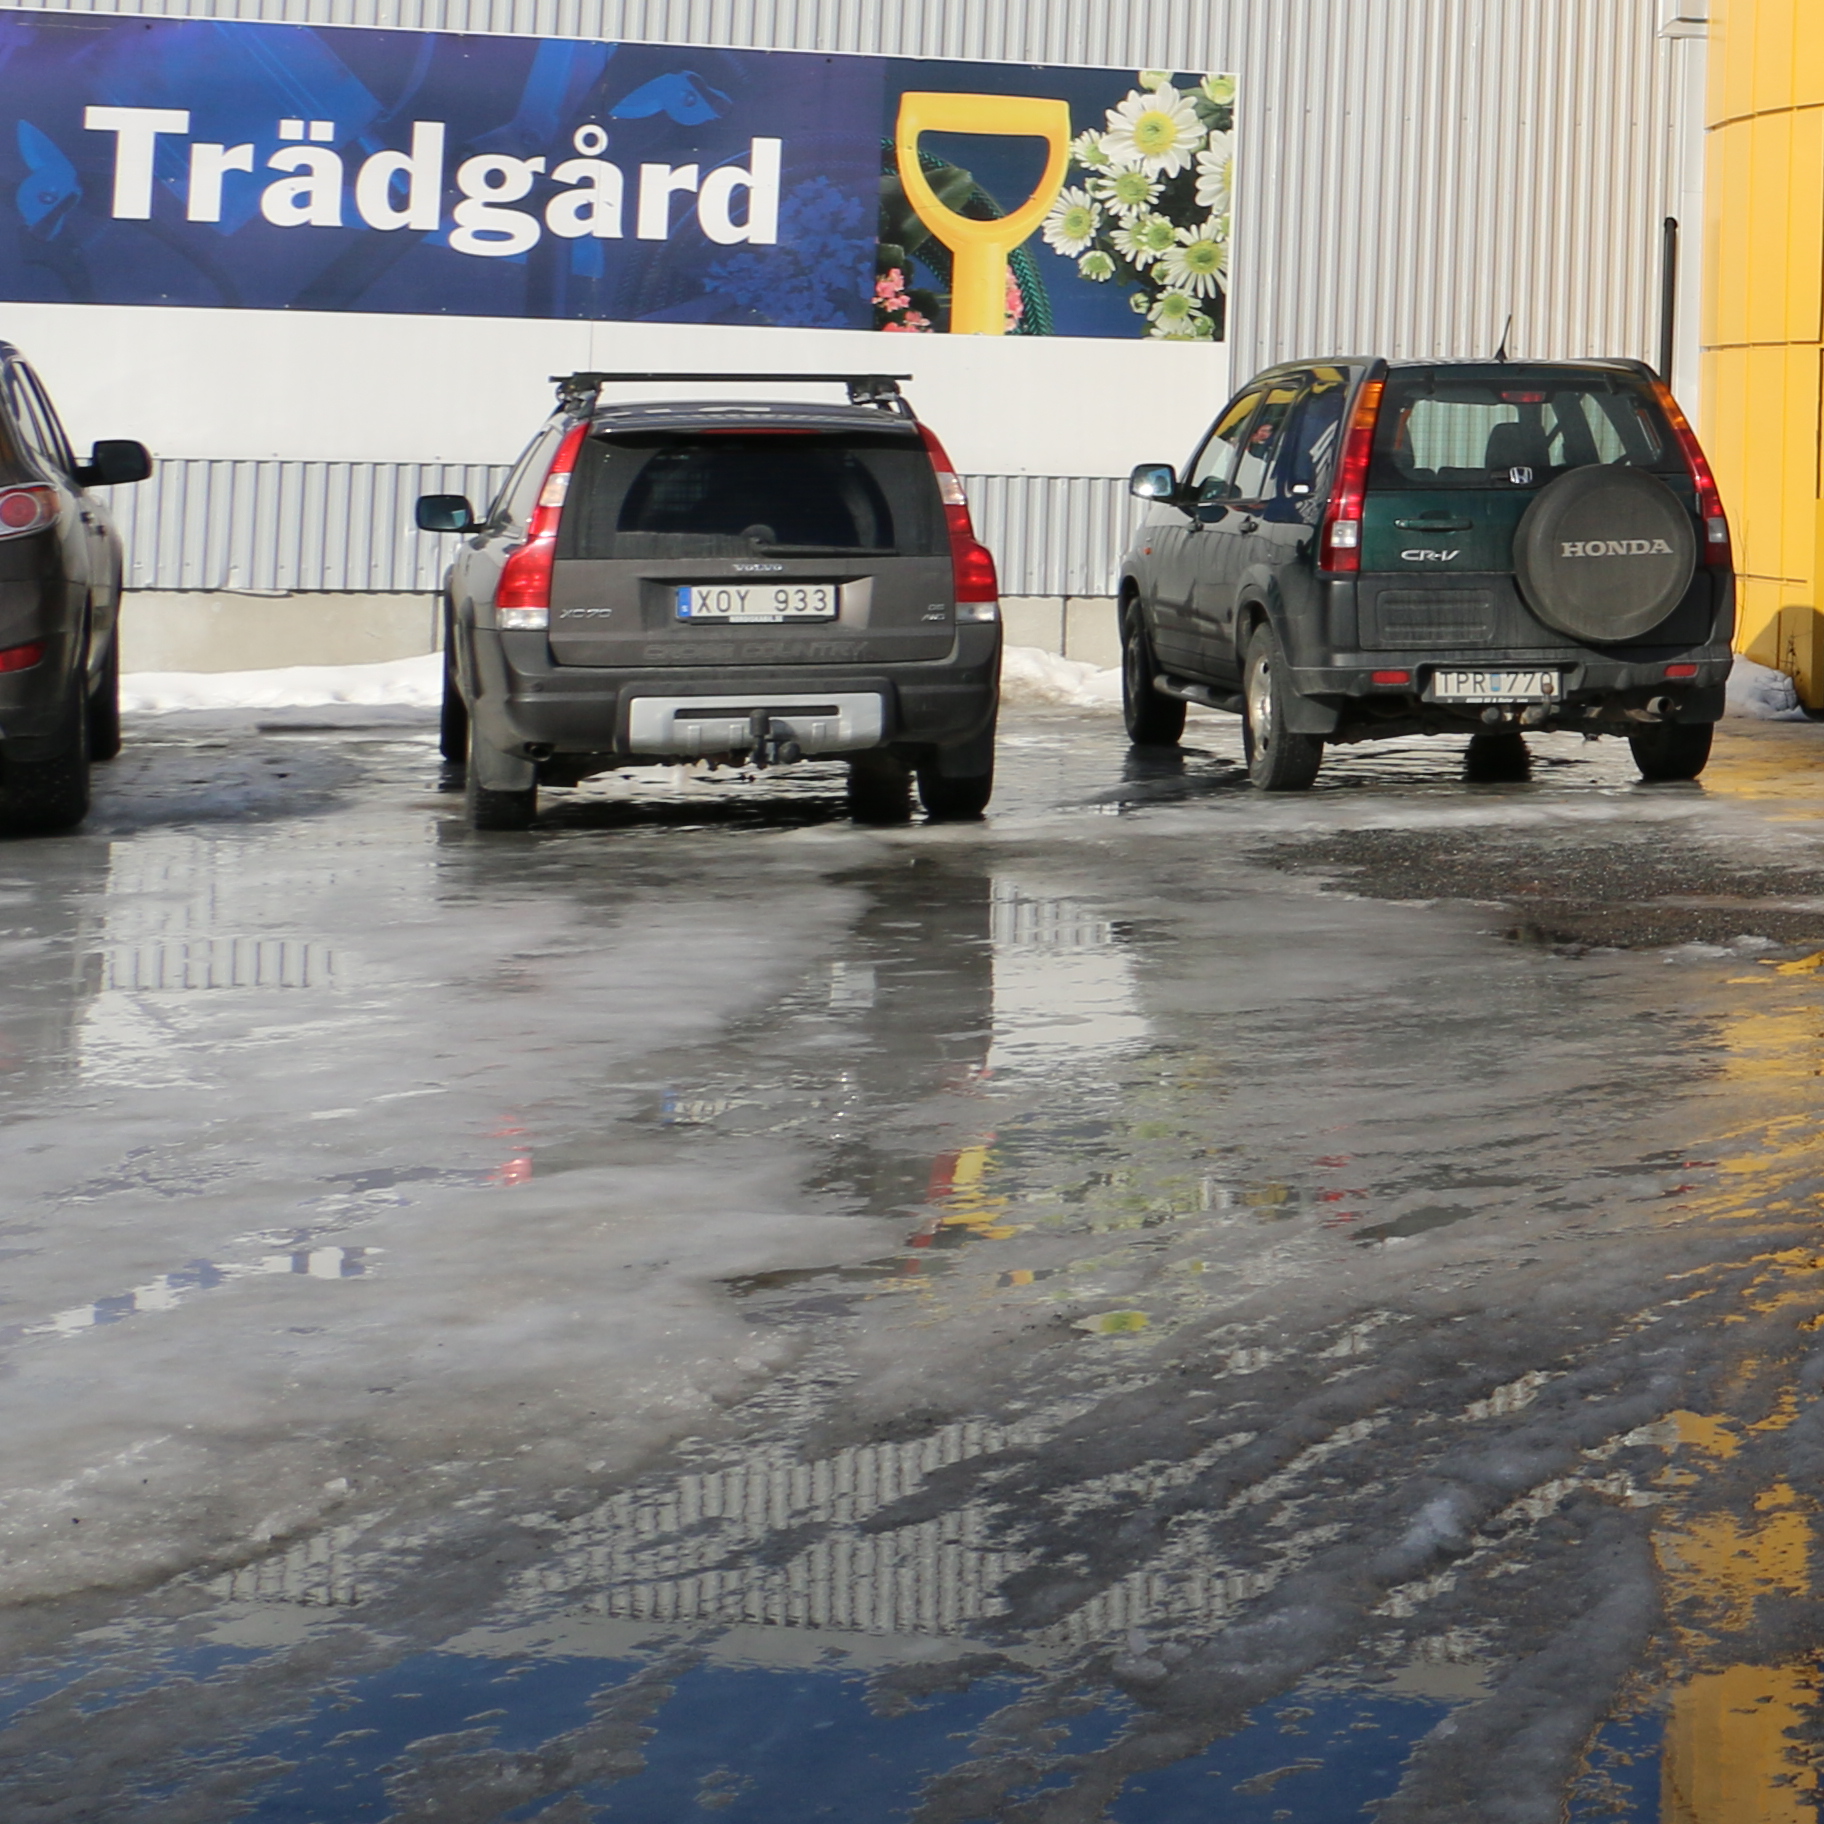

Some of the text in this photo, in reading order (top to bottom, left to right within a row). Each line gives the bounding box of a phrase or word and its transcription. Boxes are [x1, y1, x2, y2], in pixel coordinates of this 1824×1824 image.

[84, 105, 783, 257] Trädgård
[1400, 549, 1460, 562] CR-V
[1561, 539, 1673, 558] HONDA
[732, 563, 783, 573] VOLVO
[697, 589, 750, 614] XOY
[774, 589, 828, 613] 933
[560, 608, 613, 619] XC70
[742, 640, 869, 660] COUNTRY
[1440, 671, 1487, 694] TPR
